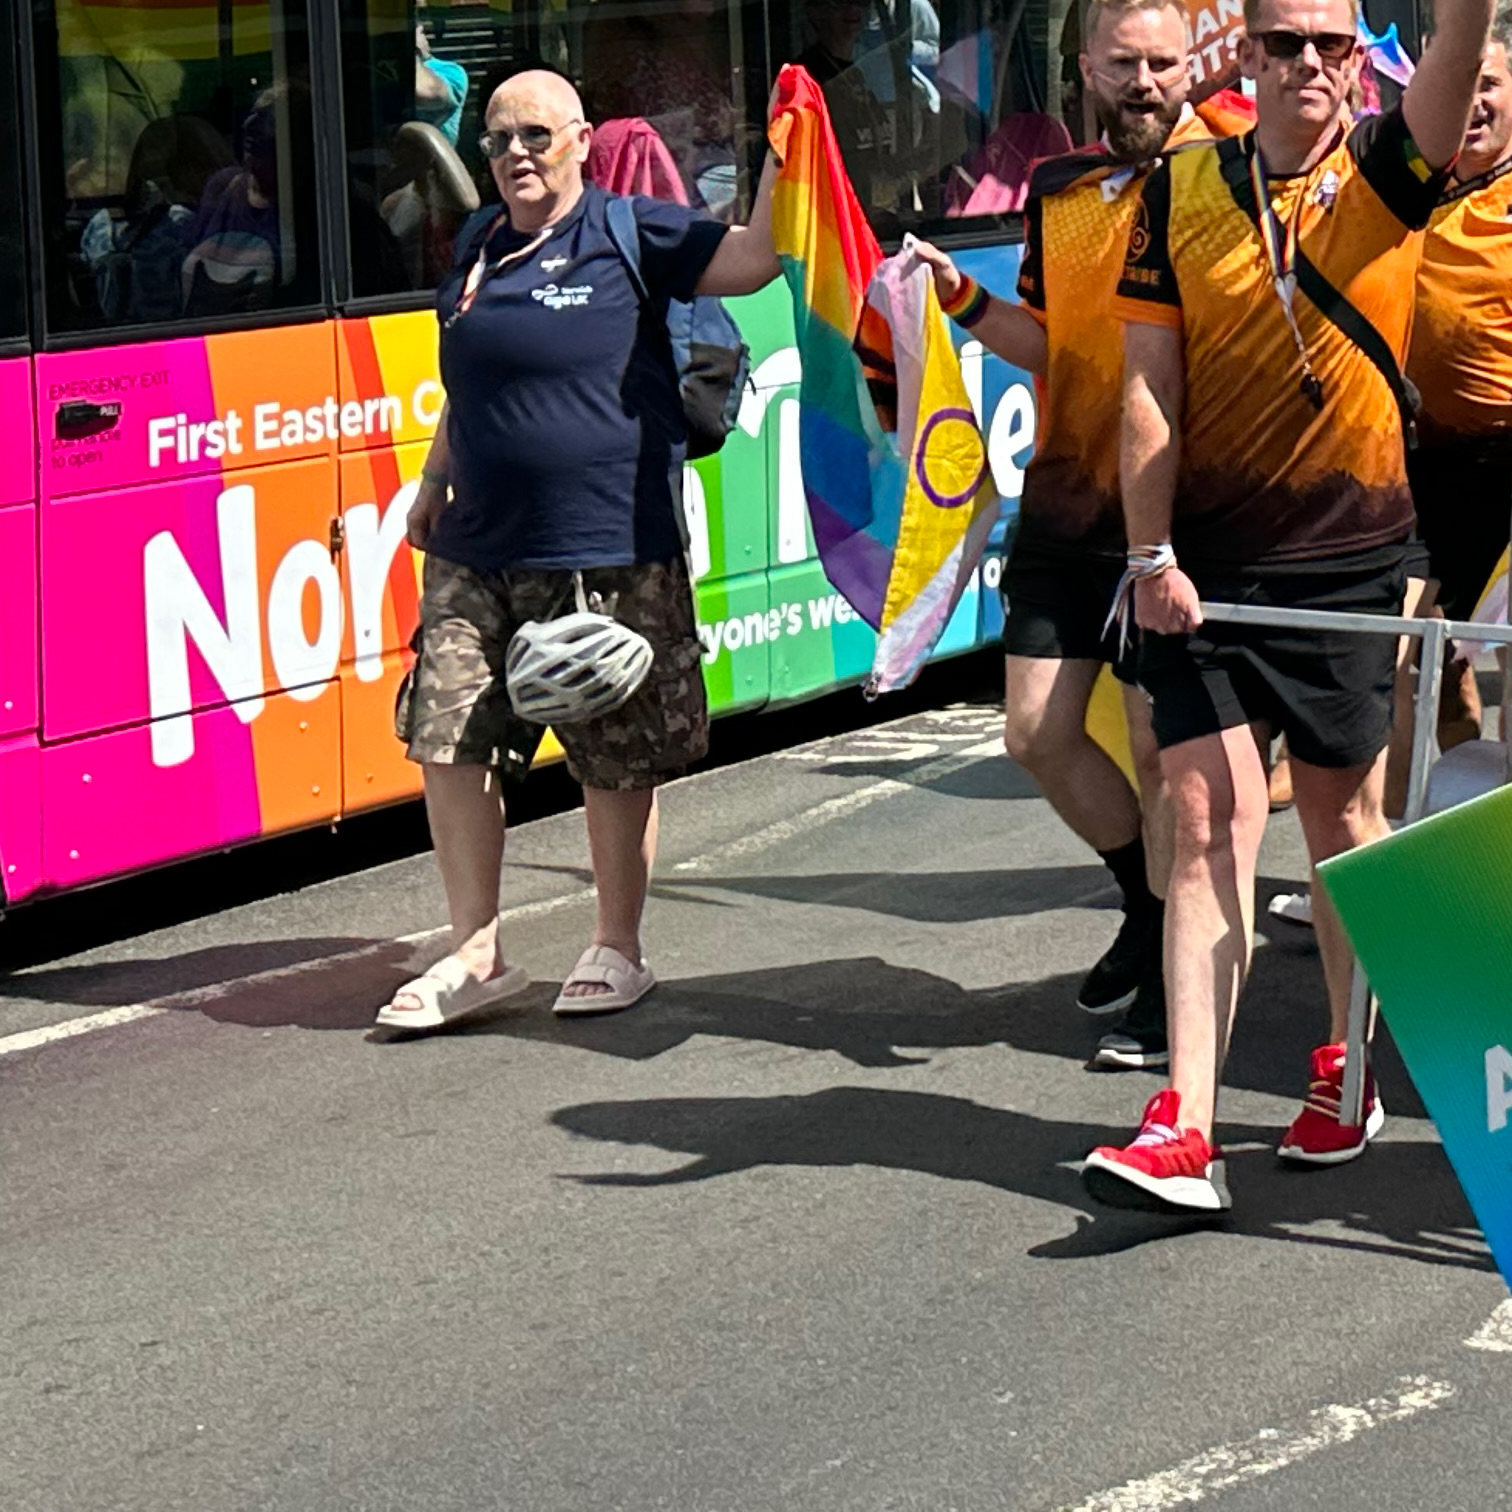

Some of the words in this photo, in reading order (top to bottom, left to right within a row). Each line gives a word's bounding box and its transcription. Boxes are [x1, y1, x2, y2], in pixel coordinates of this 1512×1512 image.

[49, 375, 138, 401] EMERGENCY
[140, 369, 171, 389] EXIT
[148, 410, 243, 469] First
[254, 395, 403, 452] Eastern
[51, 454, 66, 470] to
[67, 449, 104, 470] open
[697, 602, 804, 666] yone's
